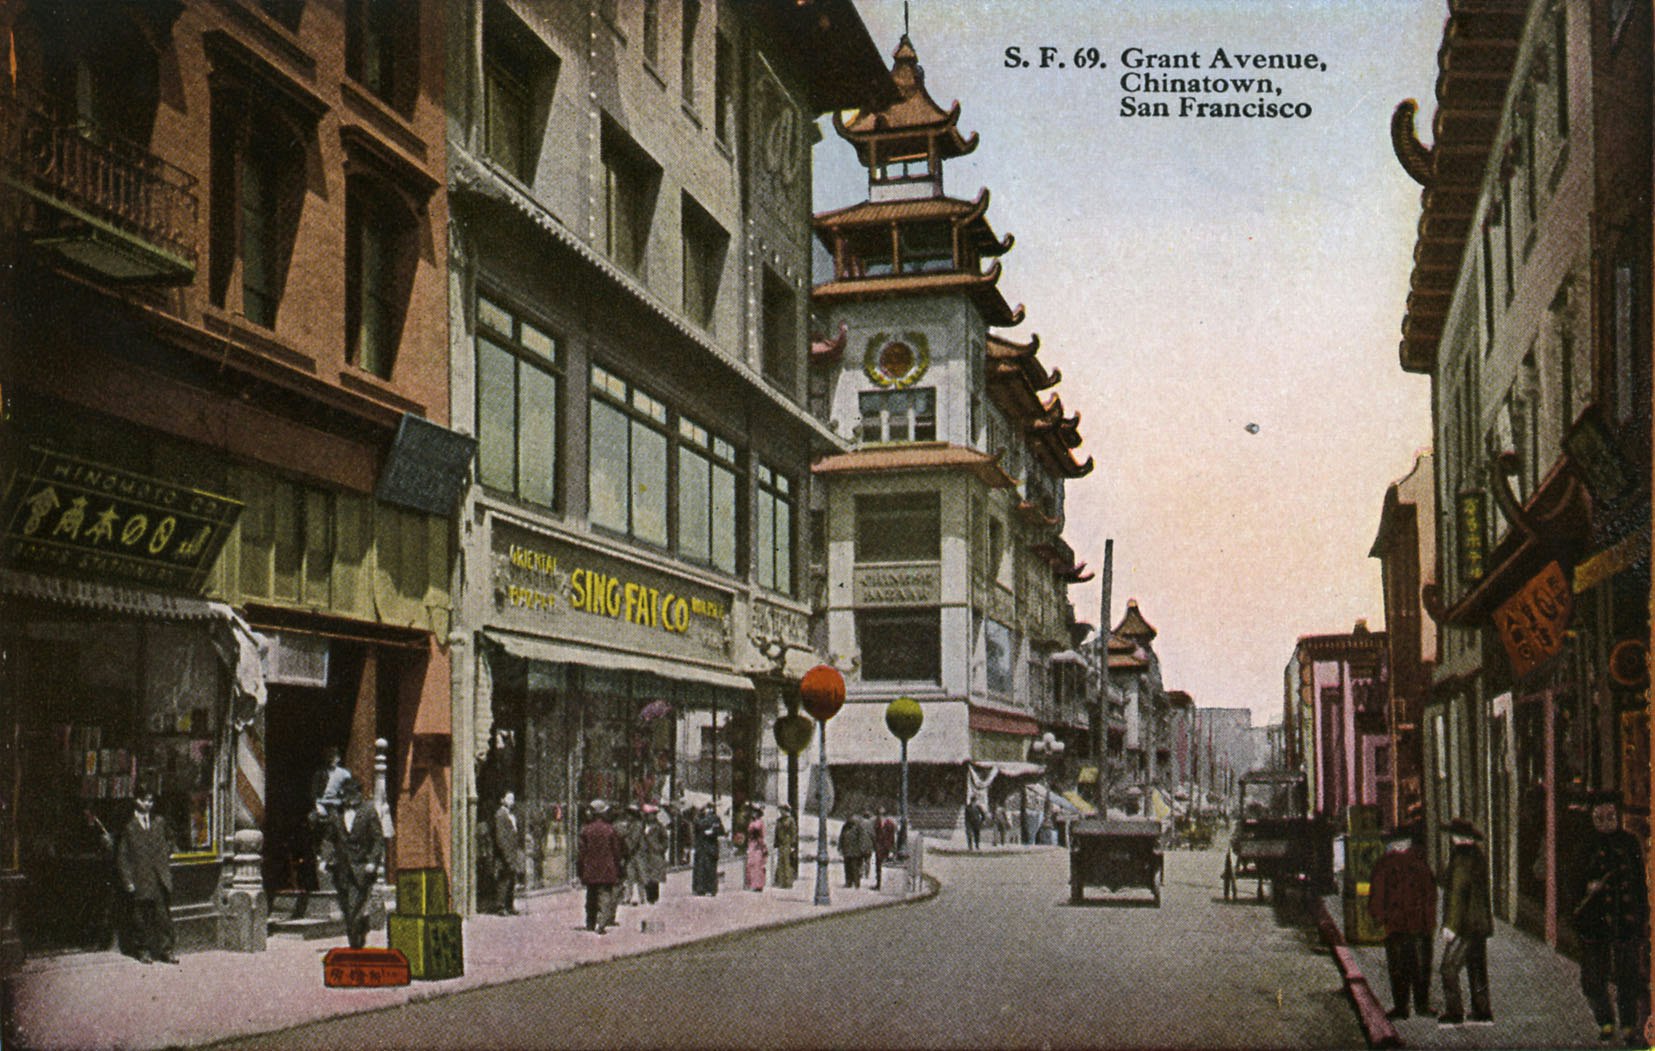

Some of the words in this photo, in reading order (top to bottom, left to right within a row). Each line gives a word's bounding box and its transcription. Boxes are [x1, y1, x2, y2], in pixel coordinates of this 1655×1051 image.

[571, 567, 620, 617] SING
[624, 581, 659, 628] FAT
[661, 592, 689, 633] CO
